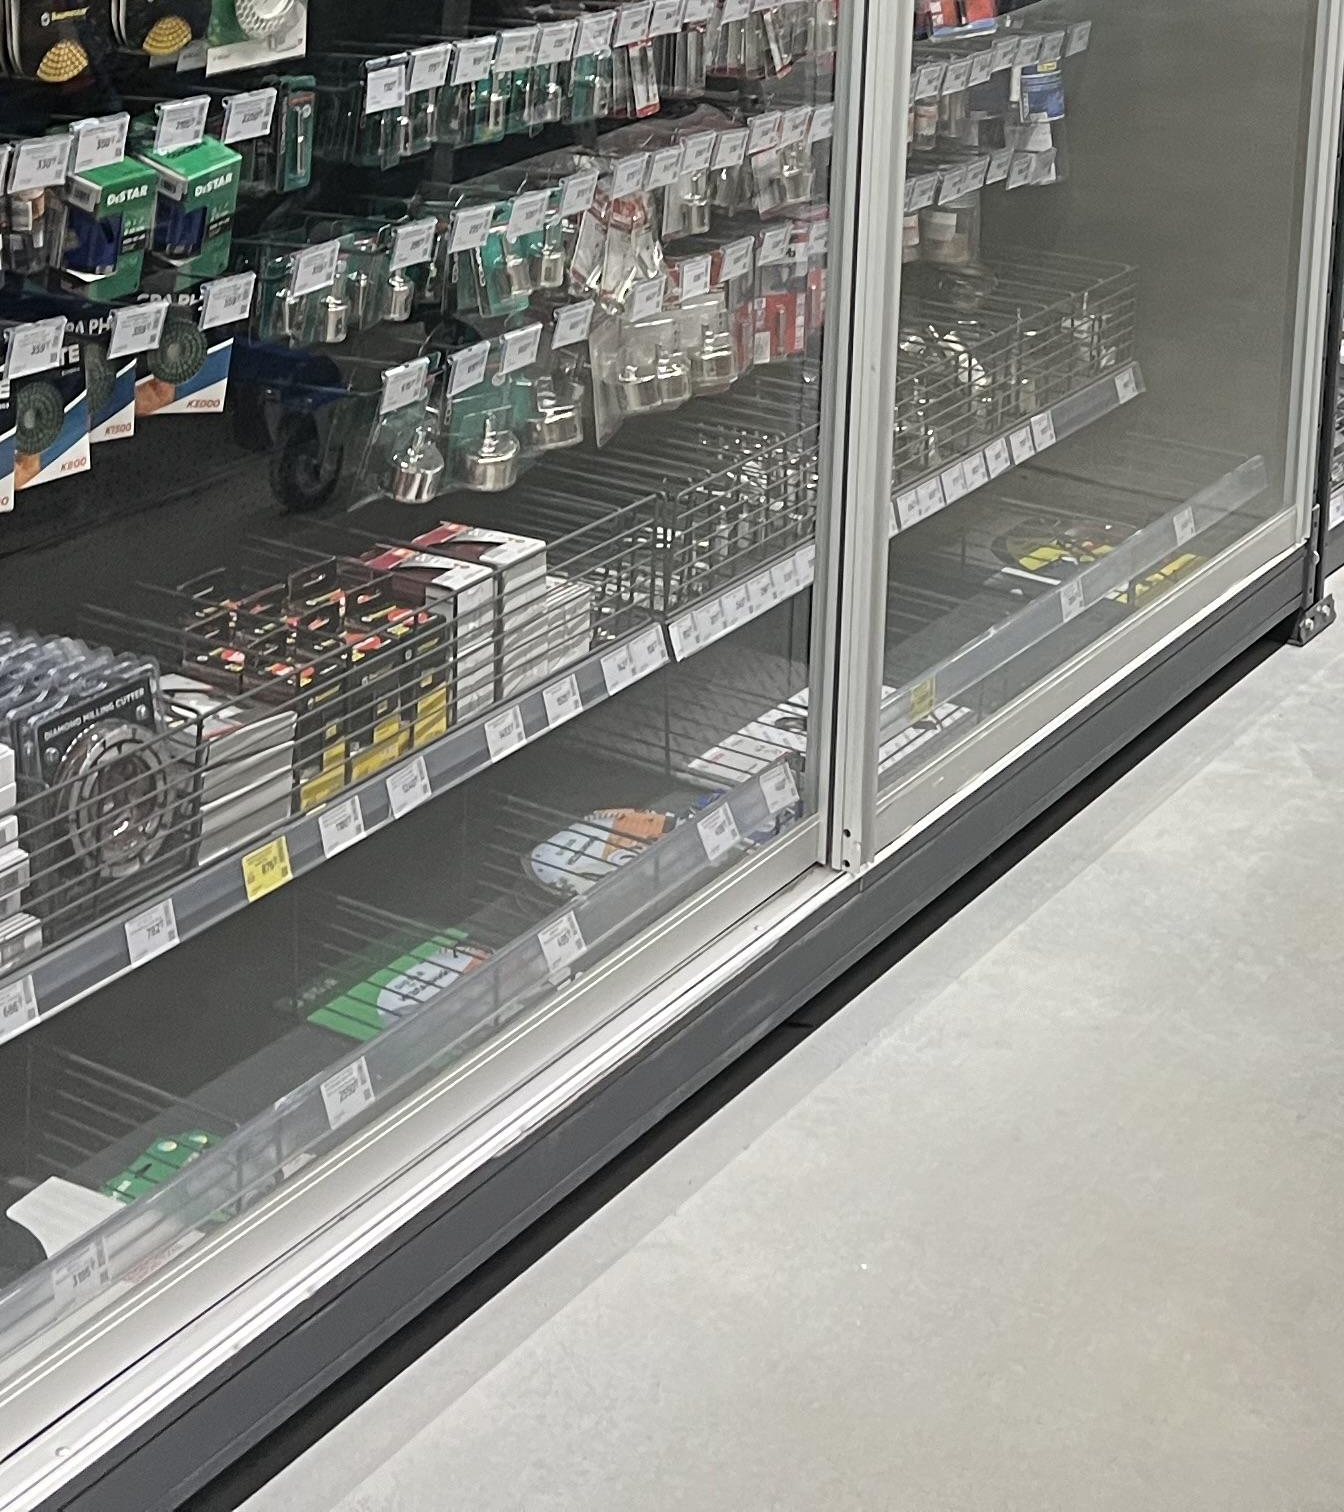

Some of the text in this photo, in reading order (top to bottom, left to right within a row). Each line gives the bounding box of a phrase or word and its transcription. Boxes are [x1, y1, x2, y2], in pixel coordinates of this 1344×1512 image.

[107, 185, 148, 207] DiSTAR
[195, 173, 233, 197] DiSTAR
[60, 457, 87, 472] K800
[44, 716, 82, 741] DIAMOND
[115, 687, 145, 709] CUTTER
